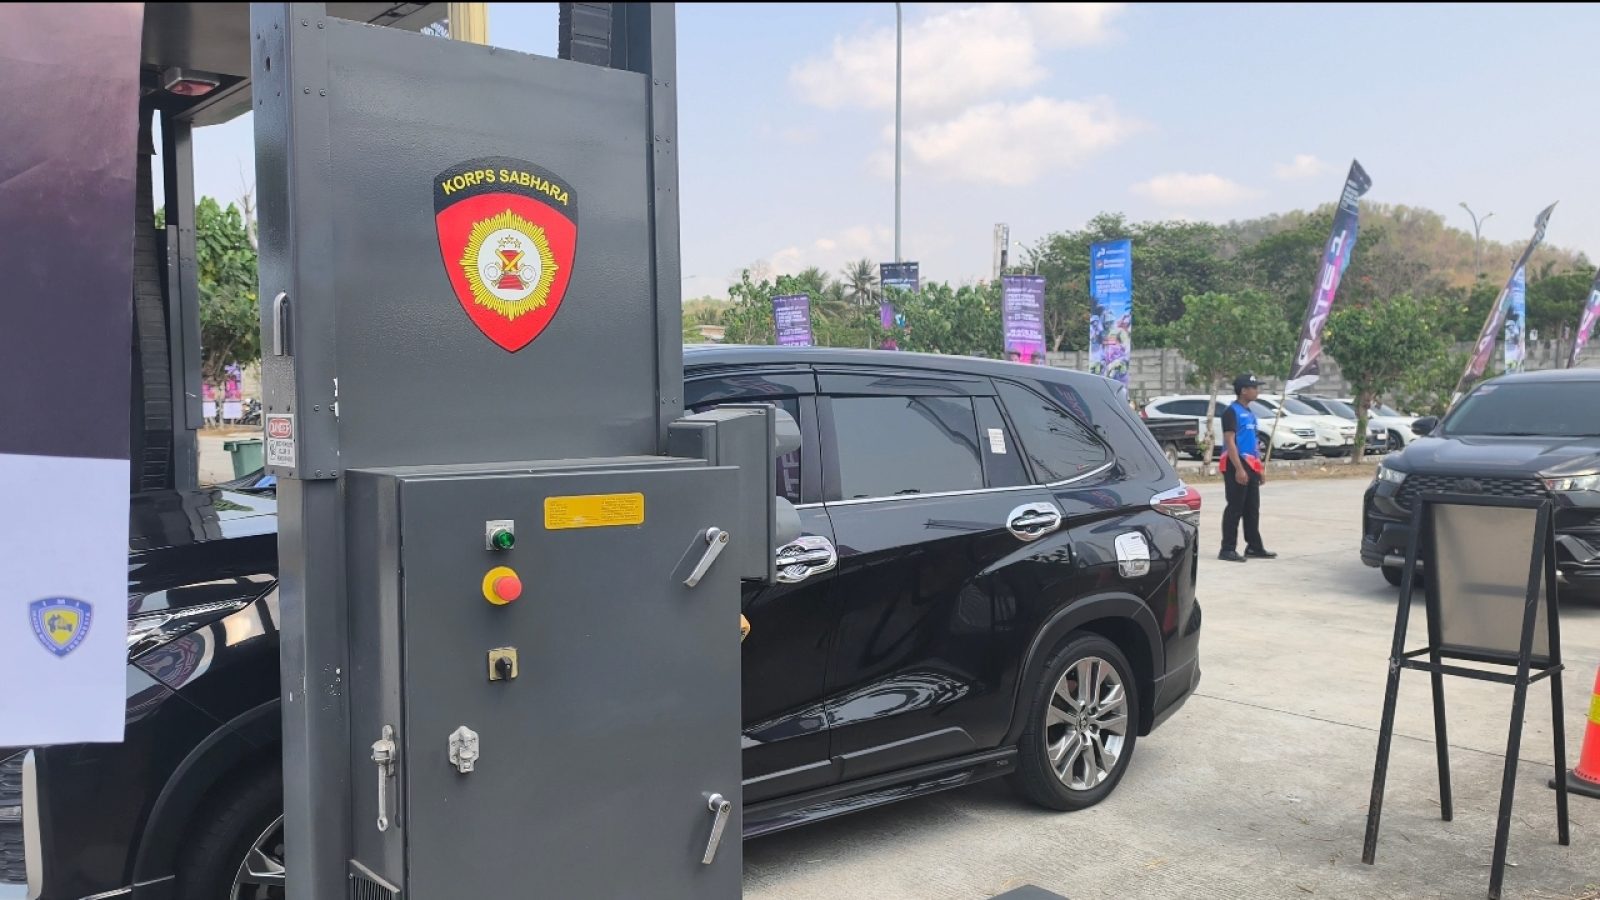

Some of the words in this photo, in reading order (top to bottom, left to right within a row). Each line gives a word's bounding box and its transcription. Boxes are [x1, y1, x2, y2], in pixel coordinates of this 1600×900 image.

[442, 169, 496, 195] KORPS
[499, 169, 570, 206] SABHARA
[1298, 263, 1336, 367] GATE
